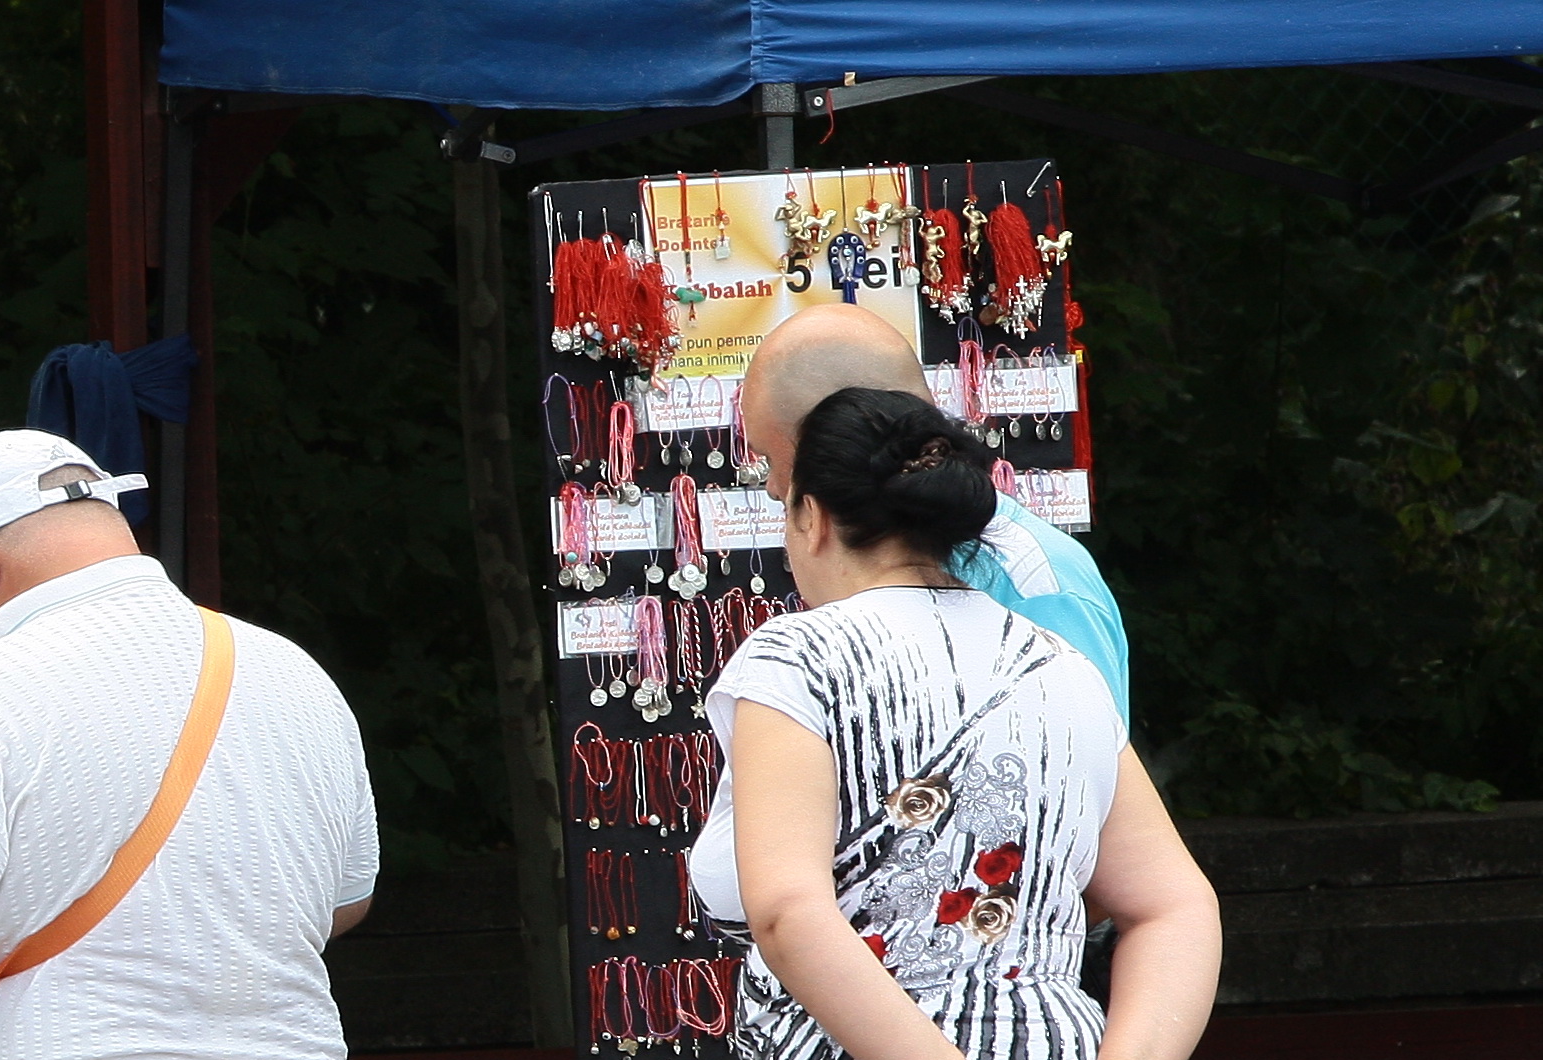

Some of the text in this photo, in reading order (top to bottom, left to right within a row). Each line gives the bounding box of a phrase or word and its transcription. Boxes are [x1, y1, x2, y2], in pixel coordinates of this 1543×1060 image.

[786, 245, 903, 293] 5 ei
[662, 280, 773, 301] Kbbalah
[686, 335, 764, 351] pun peman
